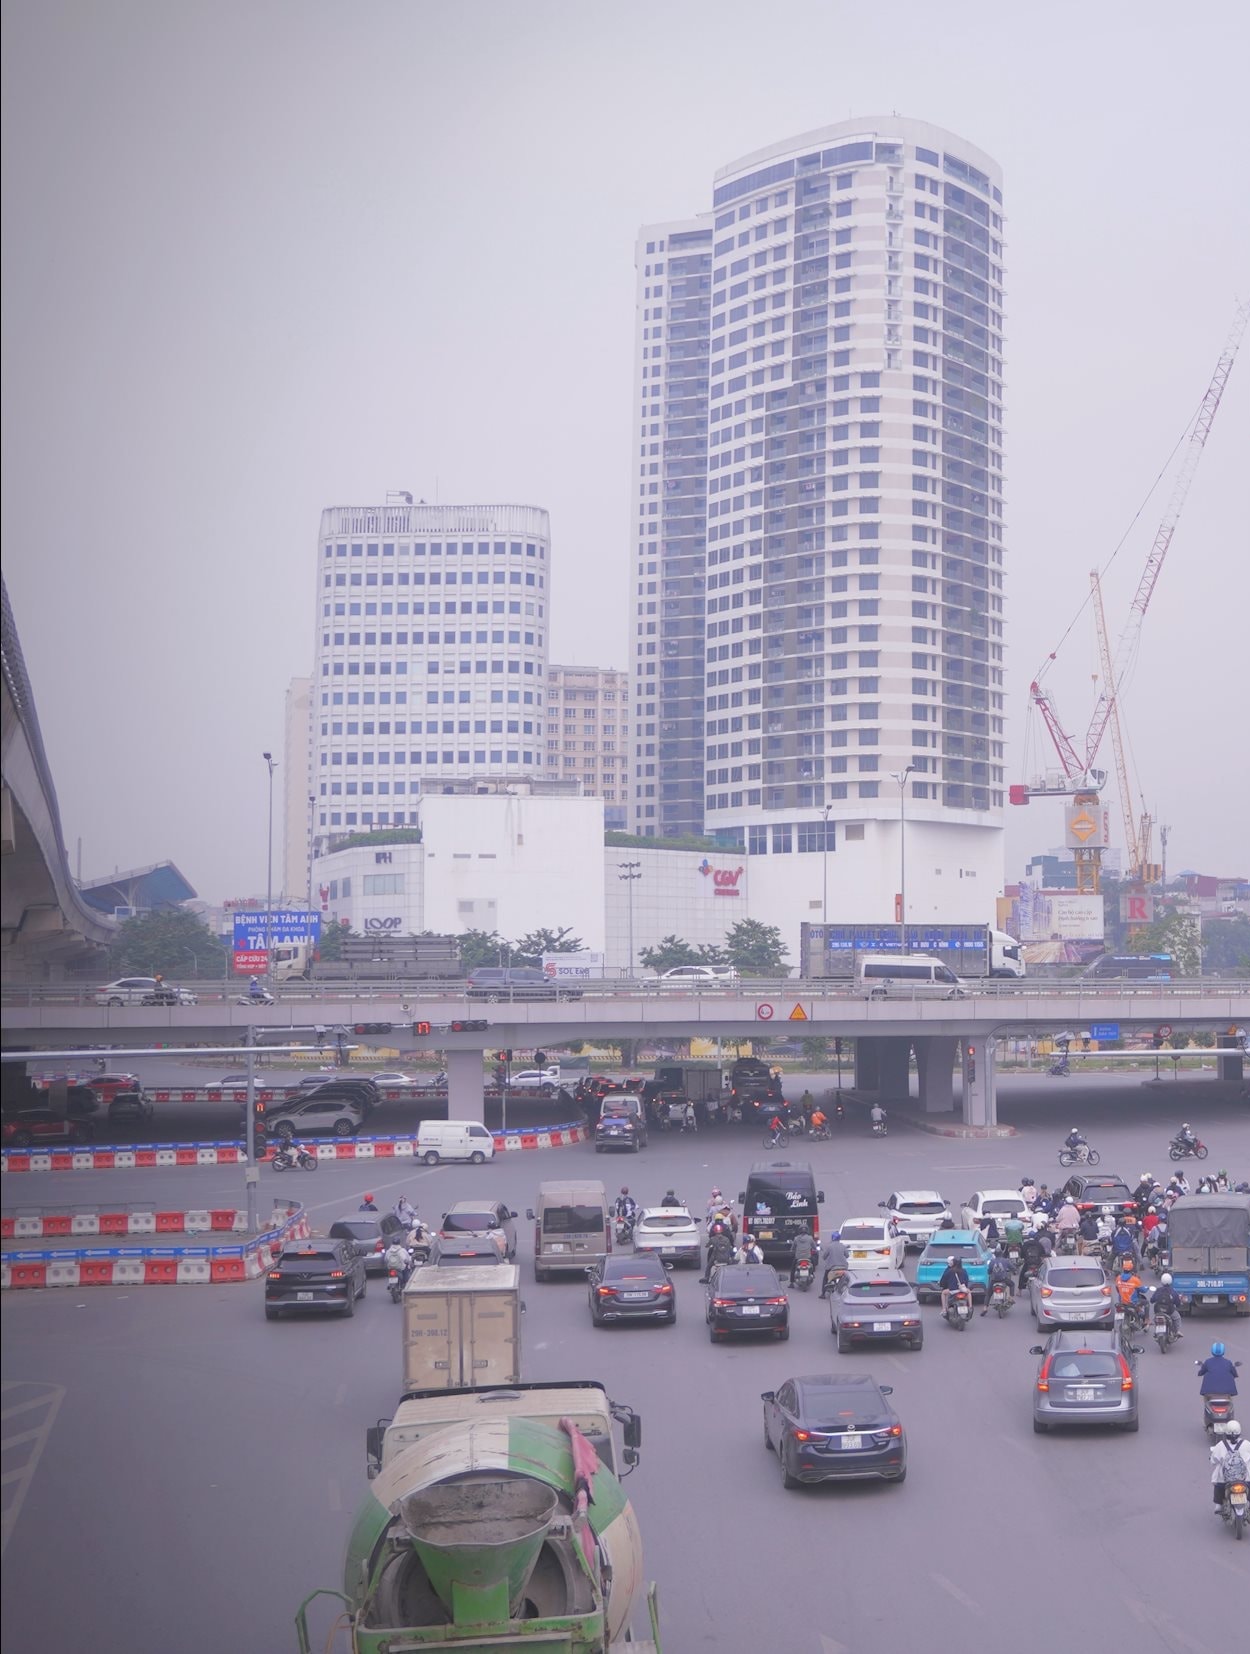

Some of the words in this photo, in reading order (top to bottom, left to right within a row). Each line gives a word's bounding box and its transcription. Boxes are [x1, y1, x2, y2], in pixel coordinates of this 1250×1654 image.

[713, 866, 744, 887] CGV
[1127, 896, 1148, 919] R
[235, 914, 257, 926] BỆNH
[280, 914, 299, 924] TÂM
[364, 917, 402, 930] LOOP
[559, 967, 574, 975] SOL
